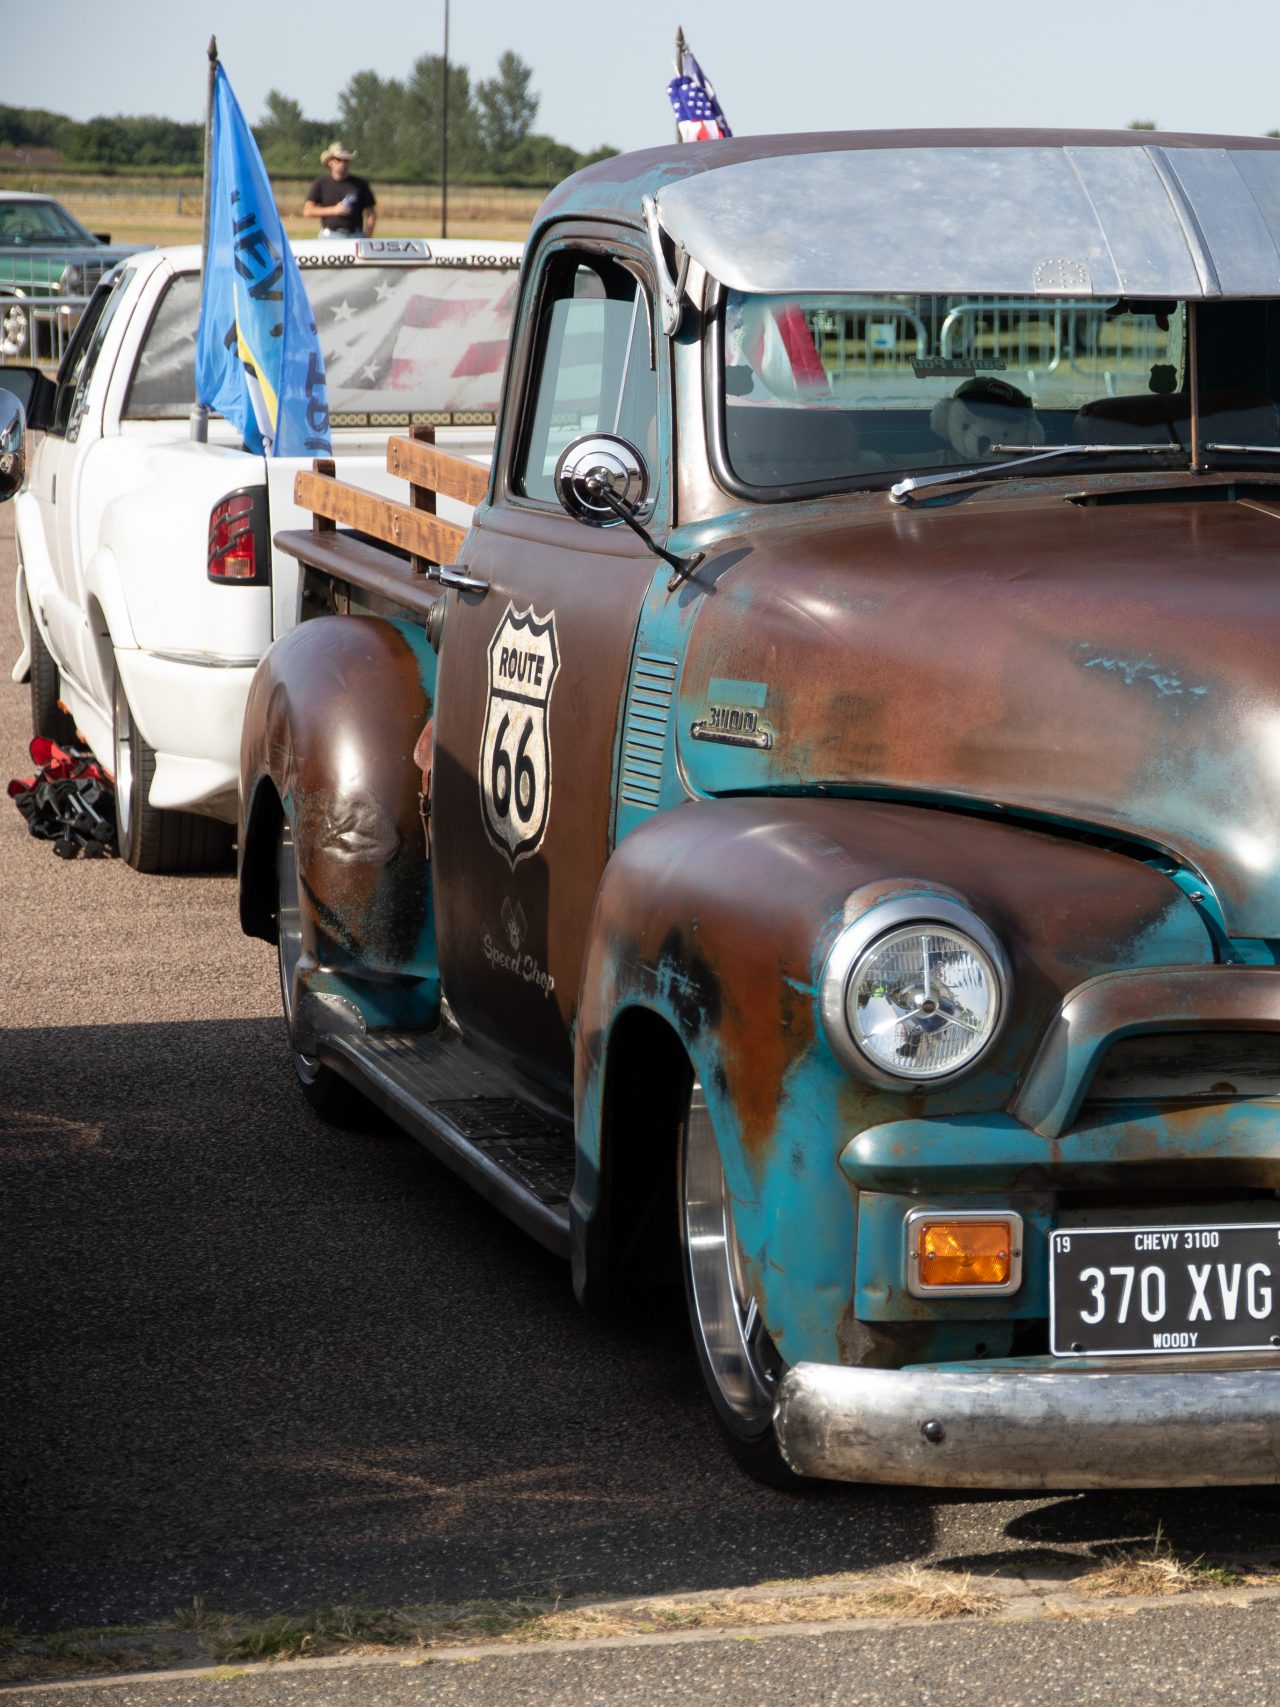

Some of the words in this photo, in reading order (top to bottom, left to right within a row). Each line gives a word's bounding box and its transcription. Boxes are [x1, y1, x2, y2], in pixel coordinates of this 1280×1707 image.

[369, 241, 419, 252] USA
[295, 255, 319, 265] OO
[321, 255, 356, 265] LOUD
[470, 254, 497, 265] TOO
[499, 646, 545, 687] ROUTE
[709, 706, 758, 733] 3100
[492, 713, 536, 823] 66
[483, 934, 521, 974] Speed
[522, 954, 555, 999] Shop
[1056, 1236, 1071, 1253] 19
[1134, 1233, 1179, 1250] CHEVY
[1184, 1232, 1219, 1249] 3100
[1079, 1265, 1167, 1325] 370
[1186, 1263, 1272, 1321] XVG
[1153, 1332, 1198, 1349] WOODY
